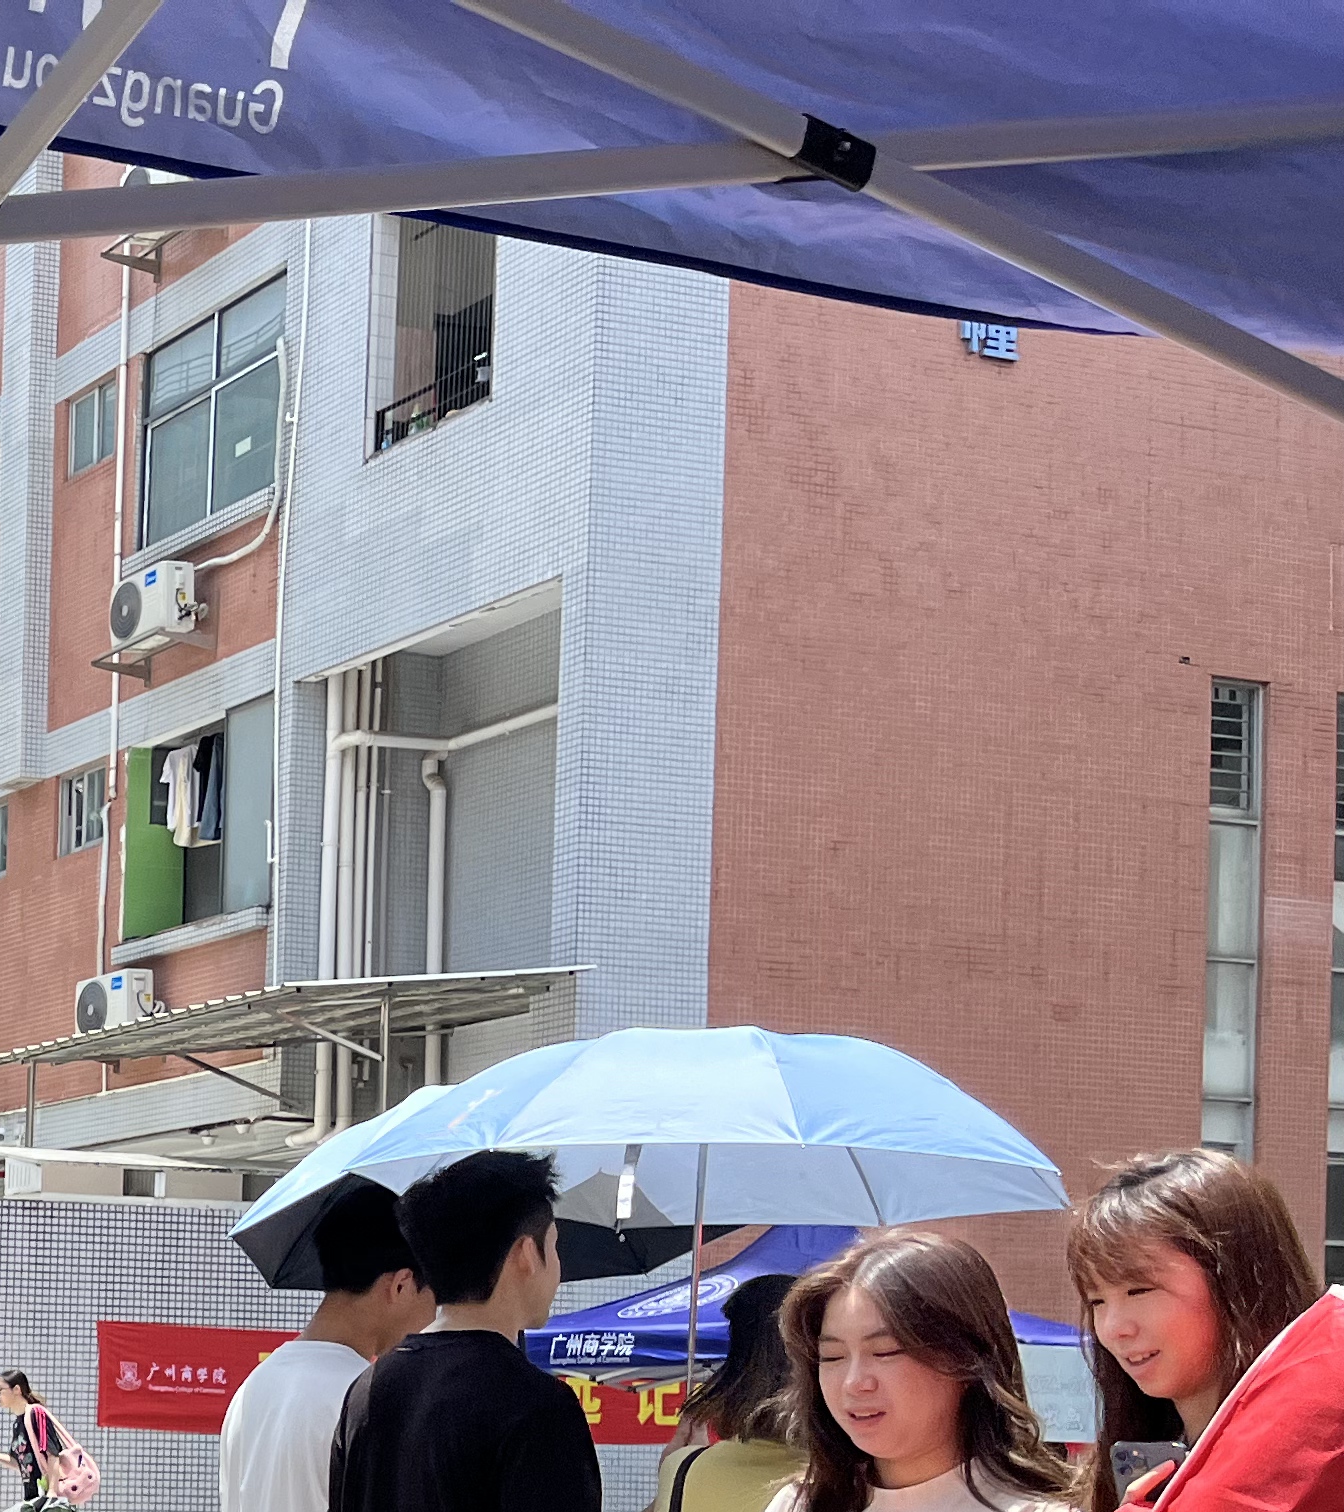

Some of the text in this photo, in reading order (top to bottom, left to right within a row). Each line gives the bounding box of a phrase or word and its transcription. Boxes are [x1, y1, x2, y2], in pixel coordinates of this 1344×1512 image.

[549, 1332, 636, 1358] 广州商学院
[146, 1361, 228, 1385] 广州商学院
